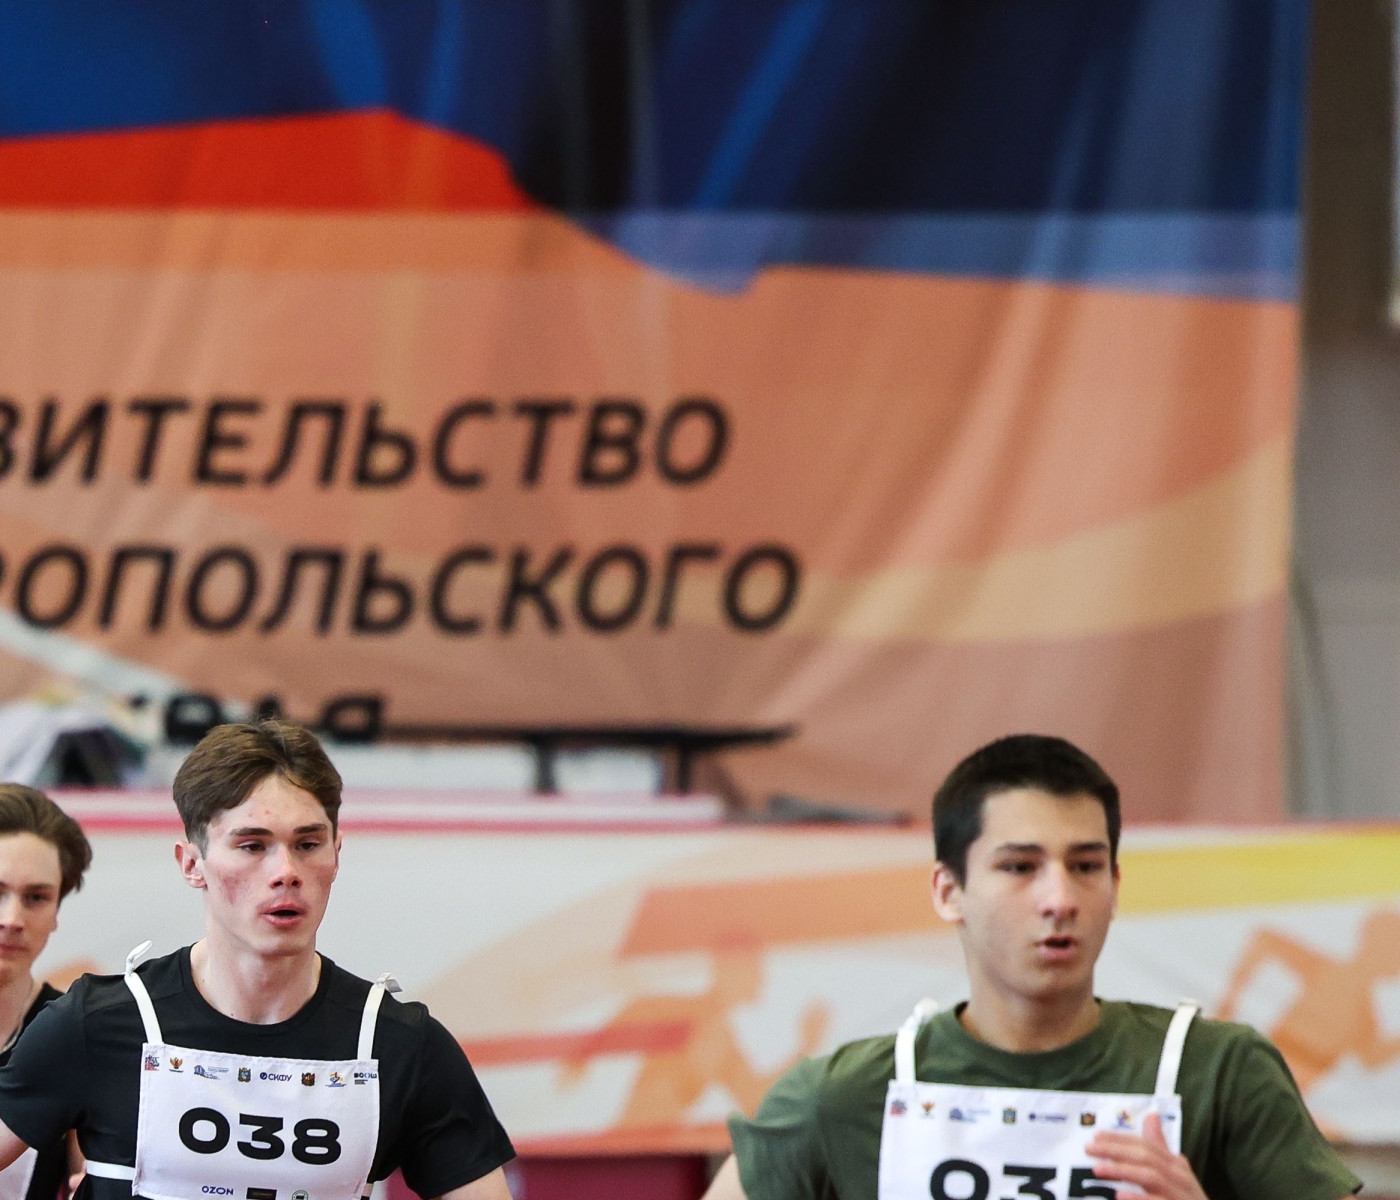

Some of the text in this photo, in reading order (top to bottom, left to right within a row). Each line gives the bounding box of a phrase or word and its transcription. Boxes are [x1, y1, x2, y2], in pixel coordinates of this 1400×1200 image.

[268, 1073, 293, 1082] СКФУ
[178, 1107, 342, 1166] 038
[201, 1185, 234, 1196] OZON
